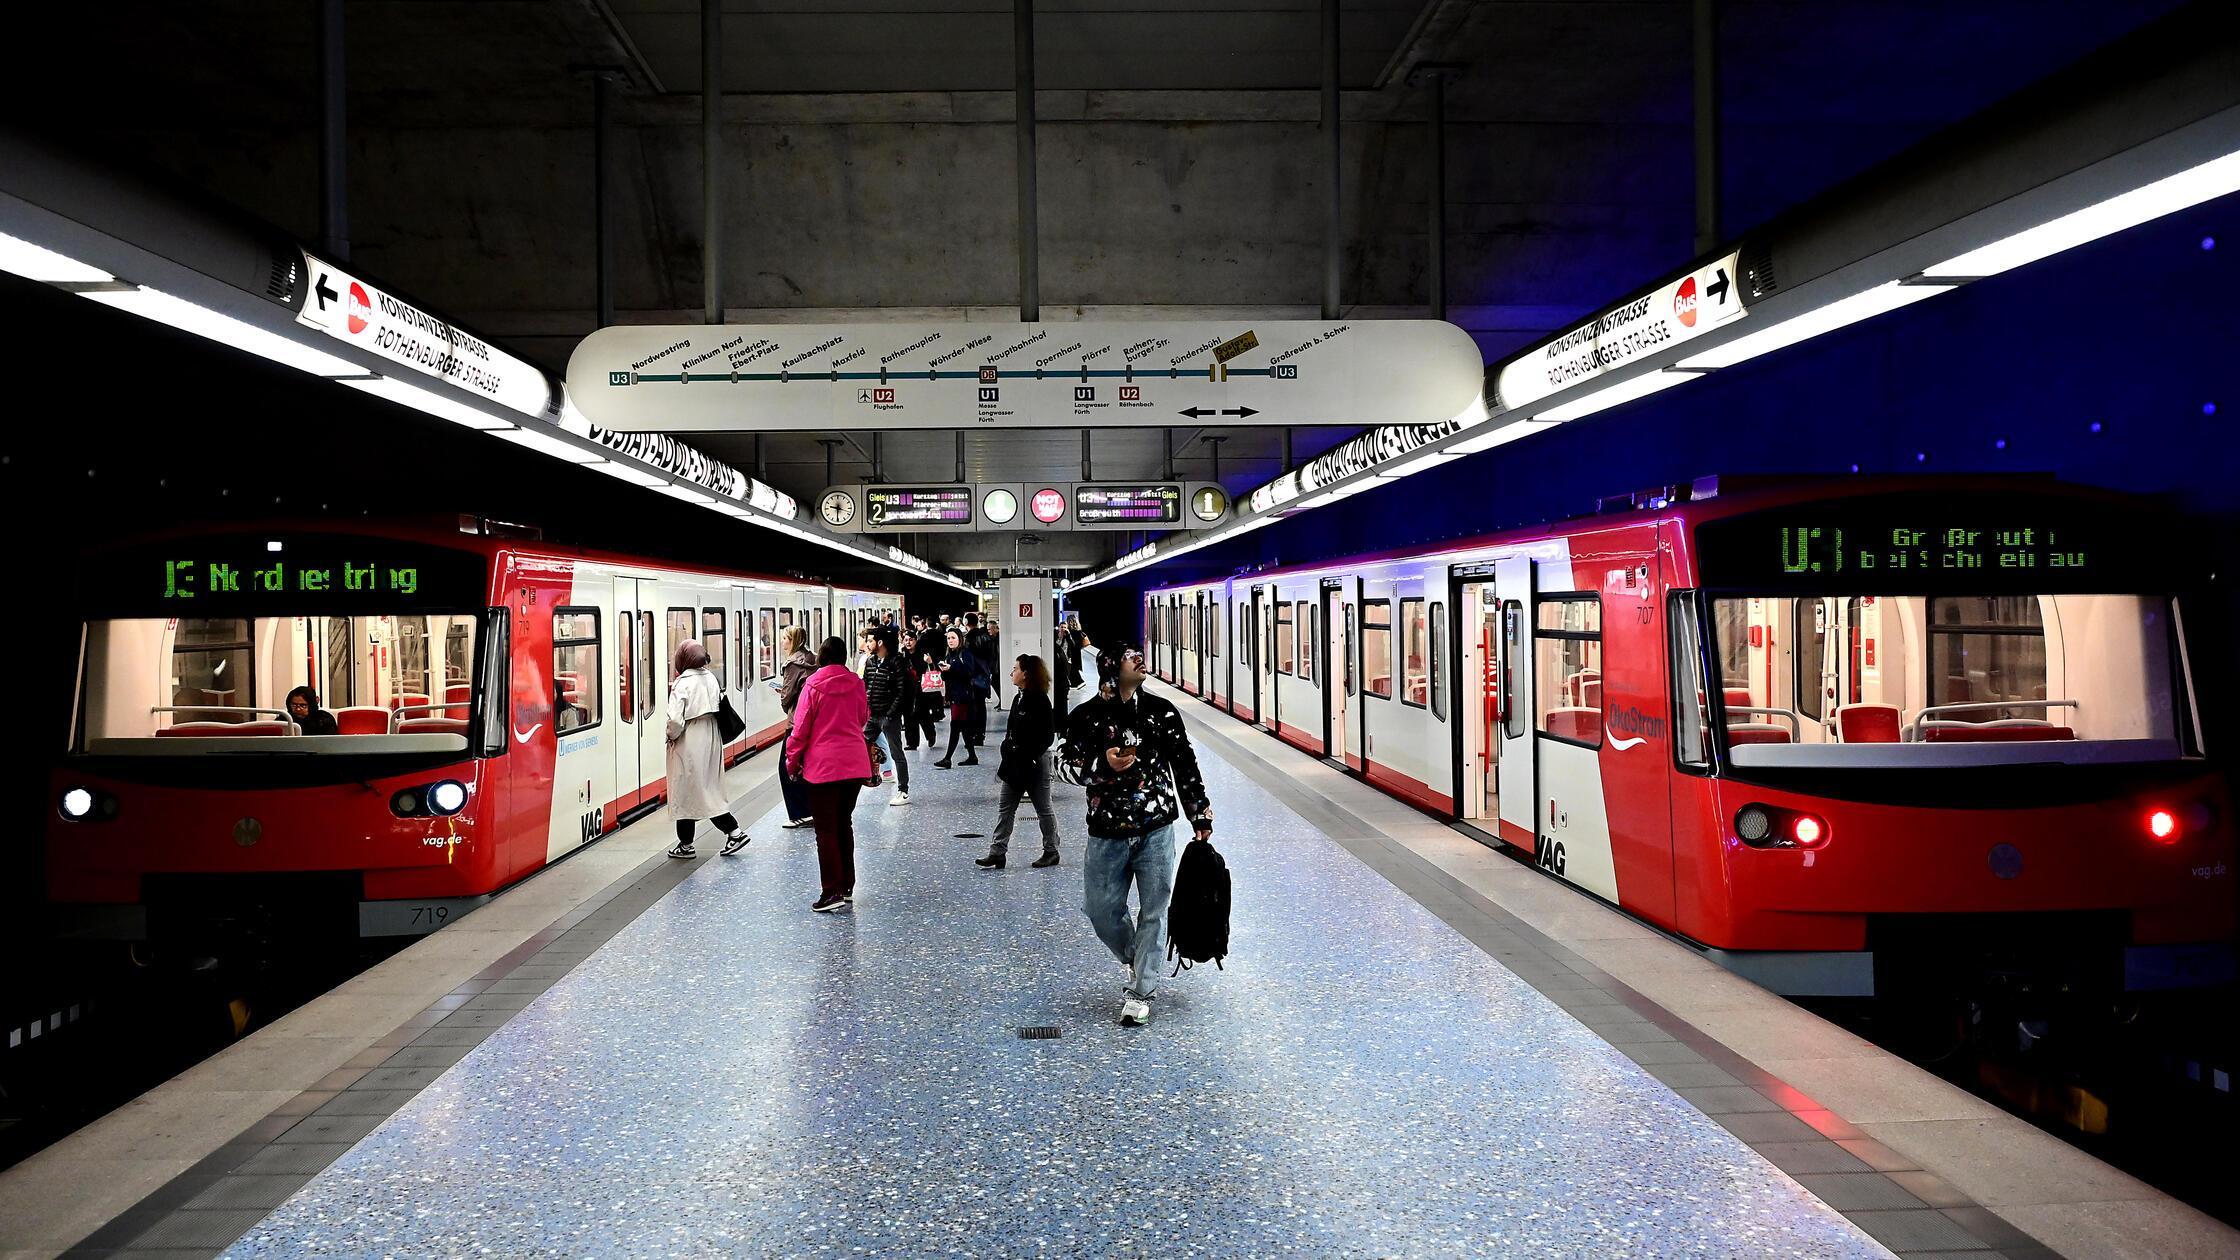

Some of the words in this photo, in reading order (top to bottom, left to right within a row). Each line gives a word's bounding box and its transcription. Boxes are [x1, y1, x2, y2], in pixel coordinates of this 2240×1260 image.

[1675, 295, 1697, 316] Bus
[377, 292, 490, 361] KONSTANZENSTRASSE
[1547, 296, 1651, 360] KONSTANZENSTRASSE
[631, 338, 691, 371] Nordwestring
[682, 348, 721, 370] Klinikum
[721, 336, 743, 351] Nord
[728, 337, 770, 362] Friedrich-
[732, 342, 780, 370] Ebert-Platz
[781, 335, 844, 369] Kaulbachplatz
[880, 331, 941, 364] Rathenauplatz
[929, 345, 965, 369] Wöhrder
[966, 334, 992, 350] Wiese
[986, 330, 1048, 364] Hauptbahnhof
[1035, 341, 1082, 367] Opernhaus
[1082, 344, 1112, 363] Plärrer
[1123, 337, 1156, 356] Rothen-
[1127, 345, 1155, 362] burger
[1155, 338, 1170, 349] Str.
[1170, 336, 1222, 366] Sündersbühl
[1270, 342, 1313, 365] Großreuth
[1323, 325, 1350, 340] Schw.
[1548, 342, 1621, 386] ROTHENBURGER
[1622, 319, 1671, 355] STRASSE
[375, 325, 463, 377] ROTHENBURGER
[462, 364, 501, 394] STRASSE
[831, 347, 866, 369] Maxfeld
[611, 373, 628, 384] U3
[982, 369, 995, 380] DB
[1279, 367, 1295, 377] U3
[875, 390, 893, 401] U2
[981, 389, 997, 400] U1
[1076, 389, 1092, 399] U1
[1121, 389, 1138, 399] U2
[873, 403, 904, 411] Flughafen
[1312, 420, 1461, 487] GUSTAV-ADOLF-STR
[869, 493, 886, 502] Gleis
[1162, 491, 1178, 499] Gleis
[872, 504, 882, 520] 2
[1166, 501, 1173, 518] 1
[1637, 606, 1655, 625] 707
[1608, 698, 1665, 739] ÖkoStrom
[581, 808, 602, 844] VAG
[422, 832, 463, 848] vag.de
[411, 906, 448, 925] 719
